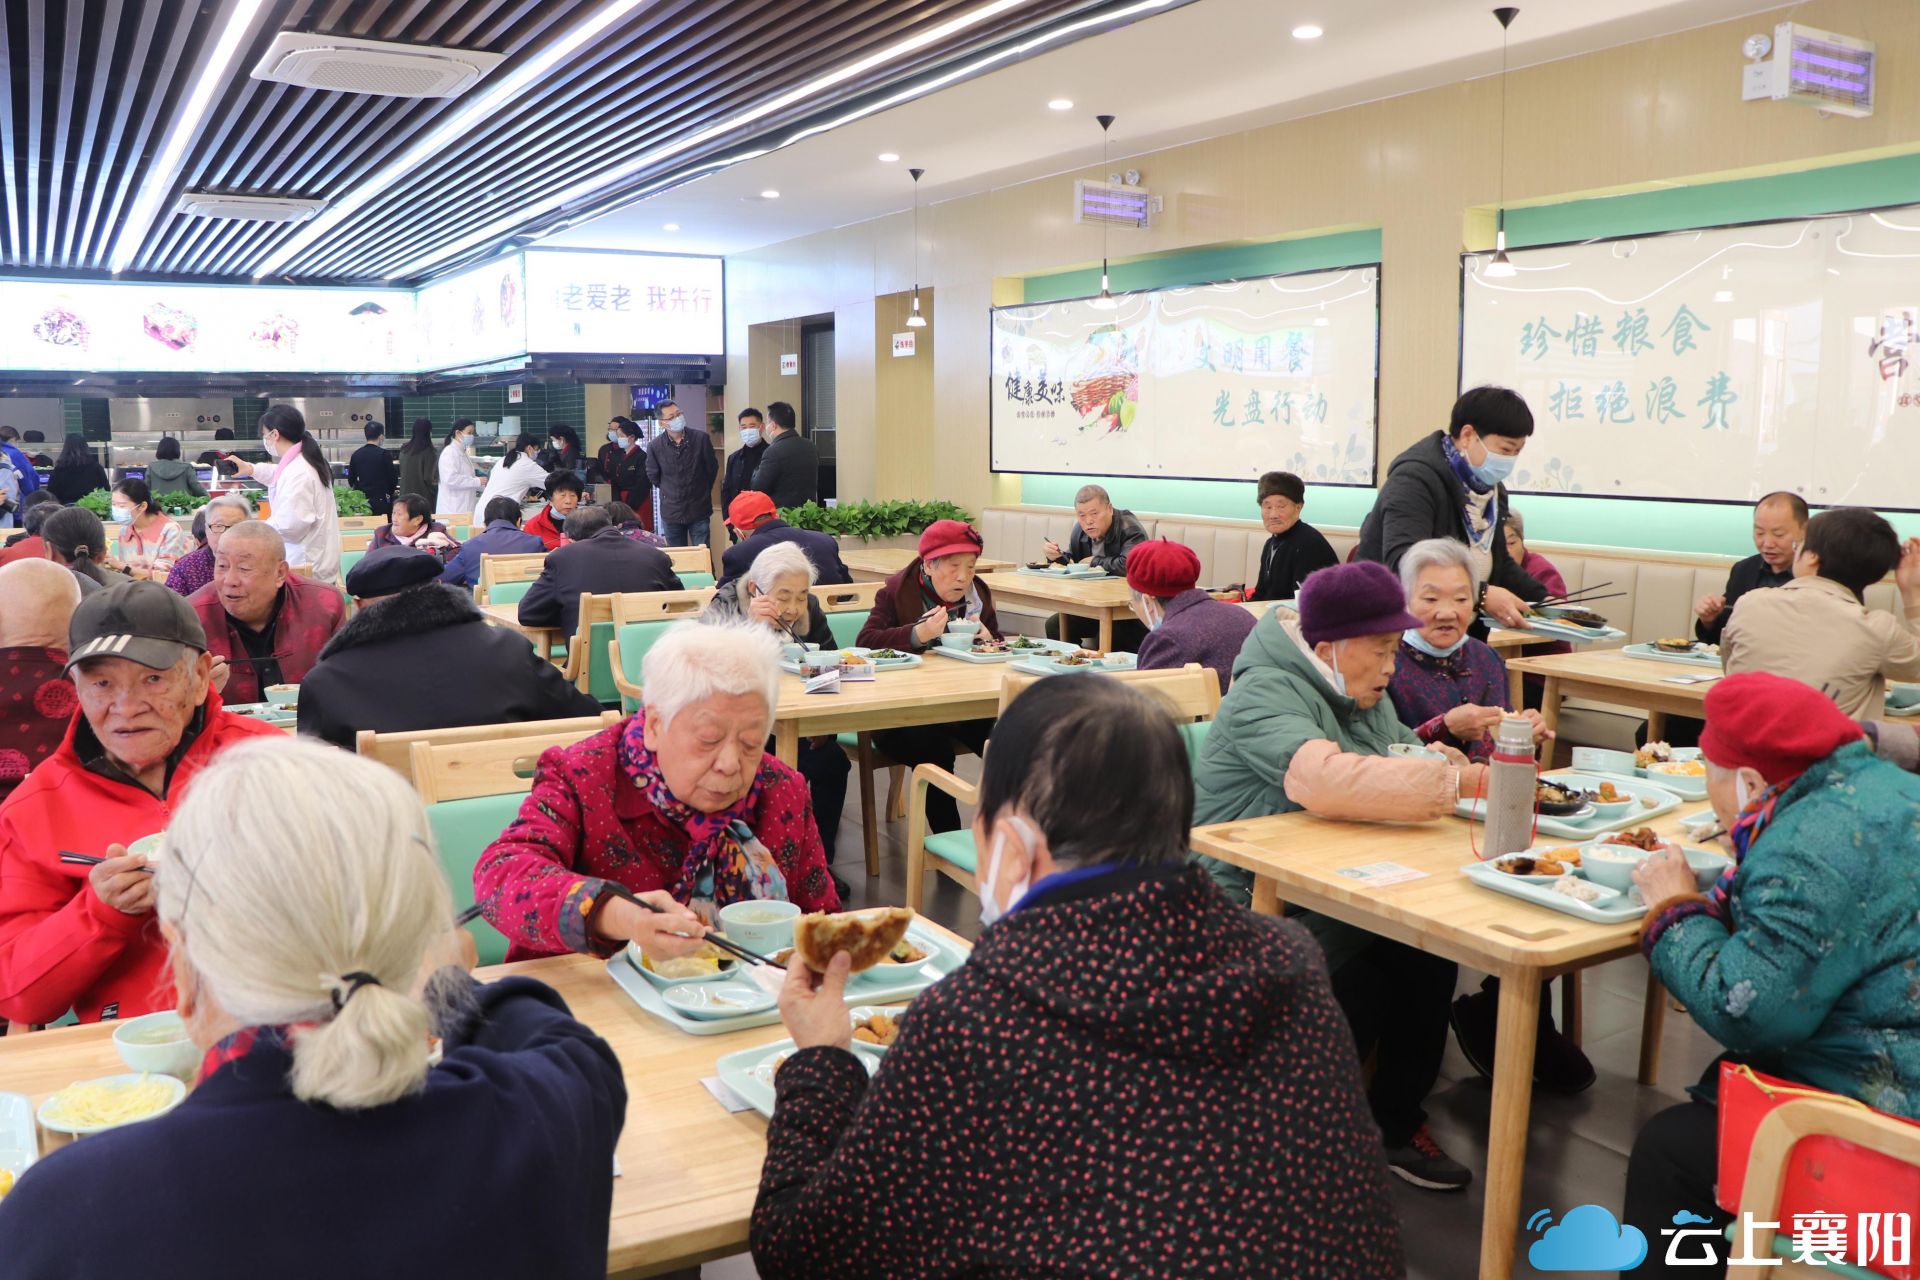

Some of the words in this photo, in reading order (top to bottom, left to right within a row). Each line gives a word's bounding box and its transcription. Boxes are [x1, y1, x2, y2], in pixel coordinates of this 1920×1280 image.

[647, 286, 712, 313] 我先行
[1196, 331, 1311, 374] 文明用餐
[1520, 303, 1711, 361] 珍惜粮食
[1005, 366, 1066, 407] 健康美味
[1212, 388, 1328, 427] 光盘行动
[1548, 371, 1739, 431] 拒绝浪费
